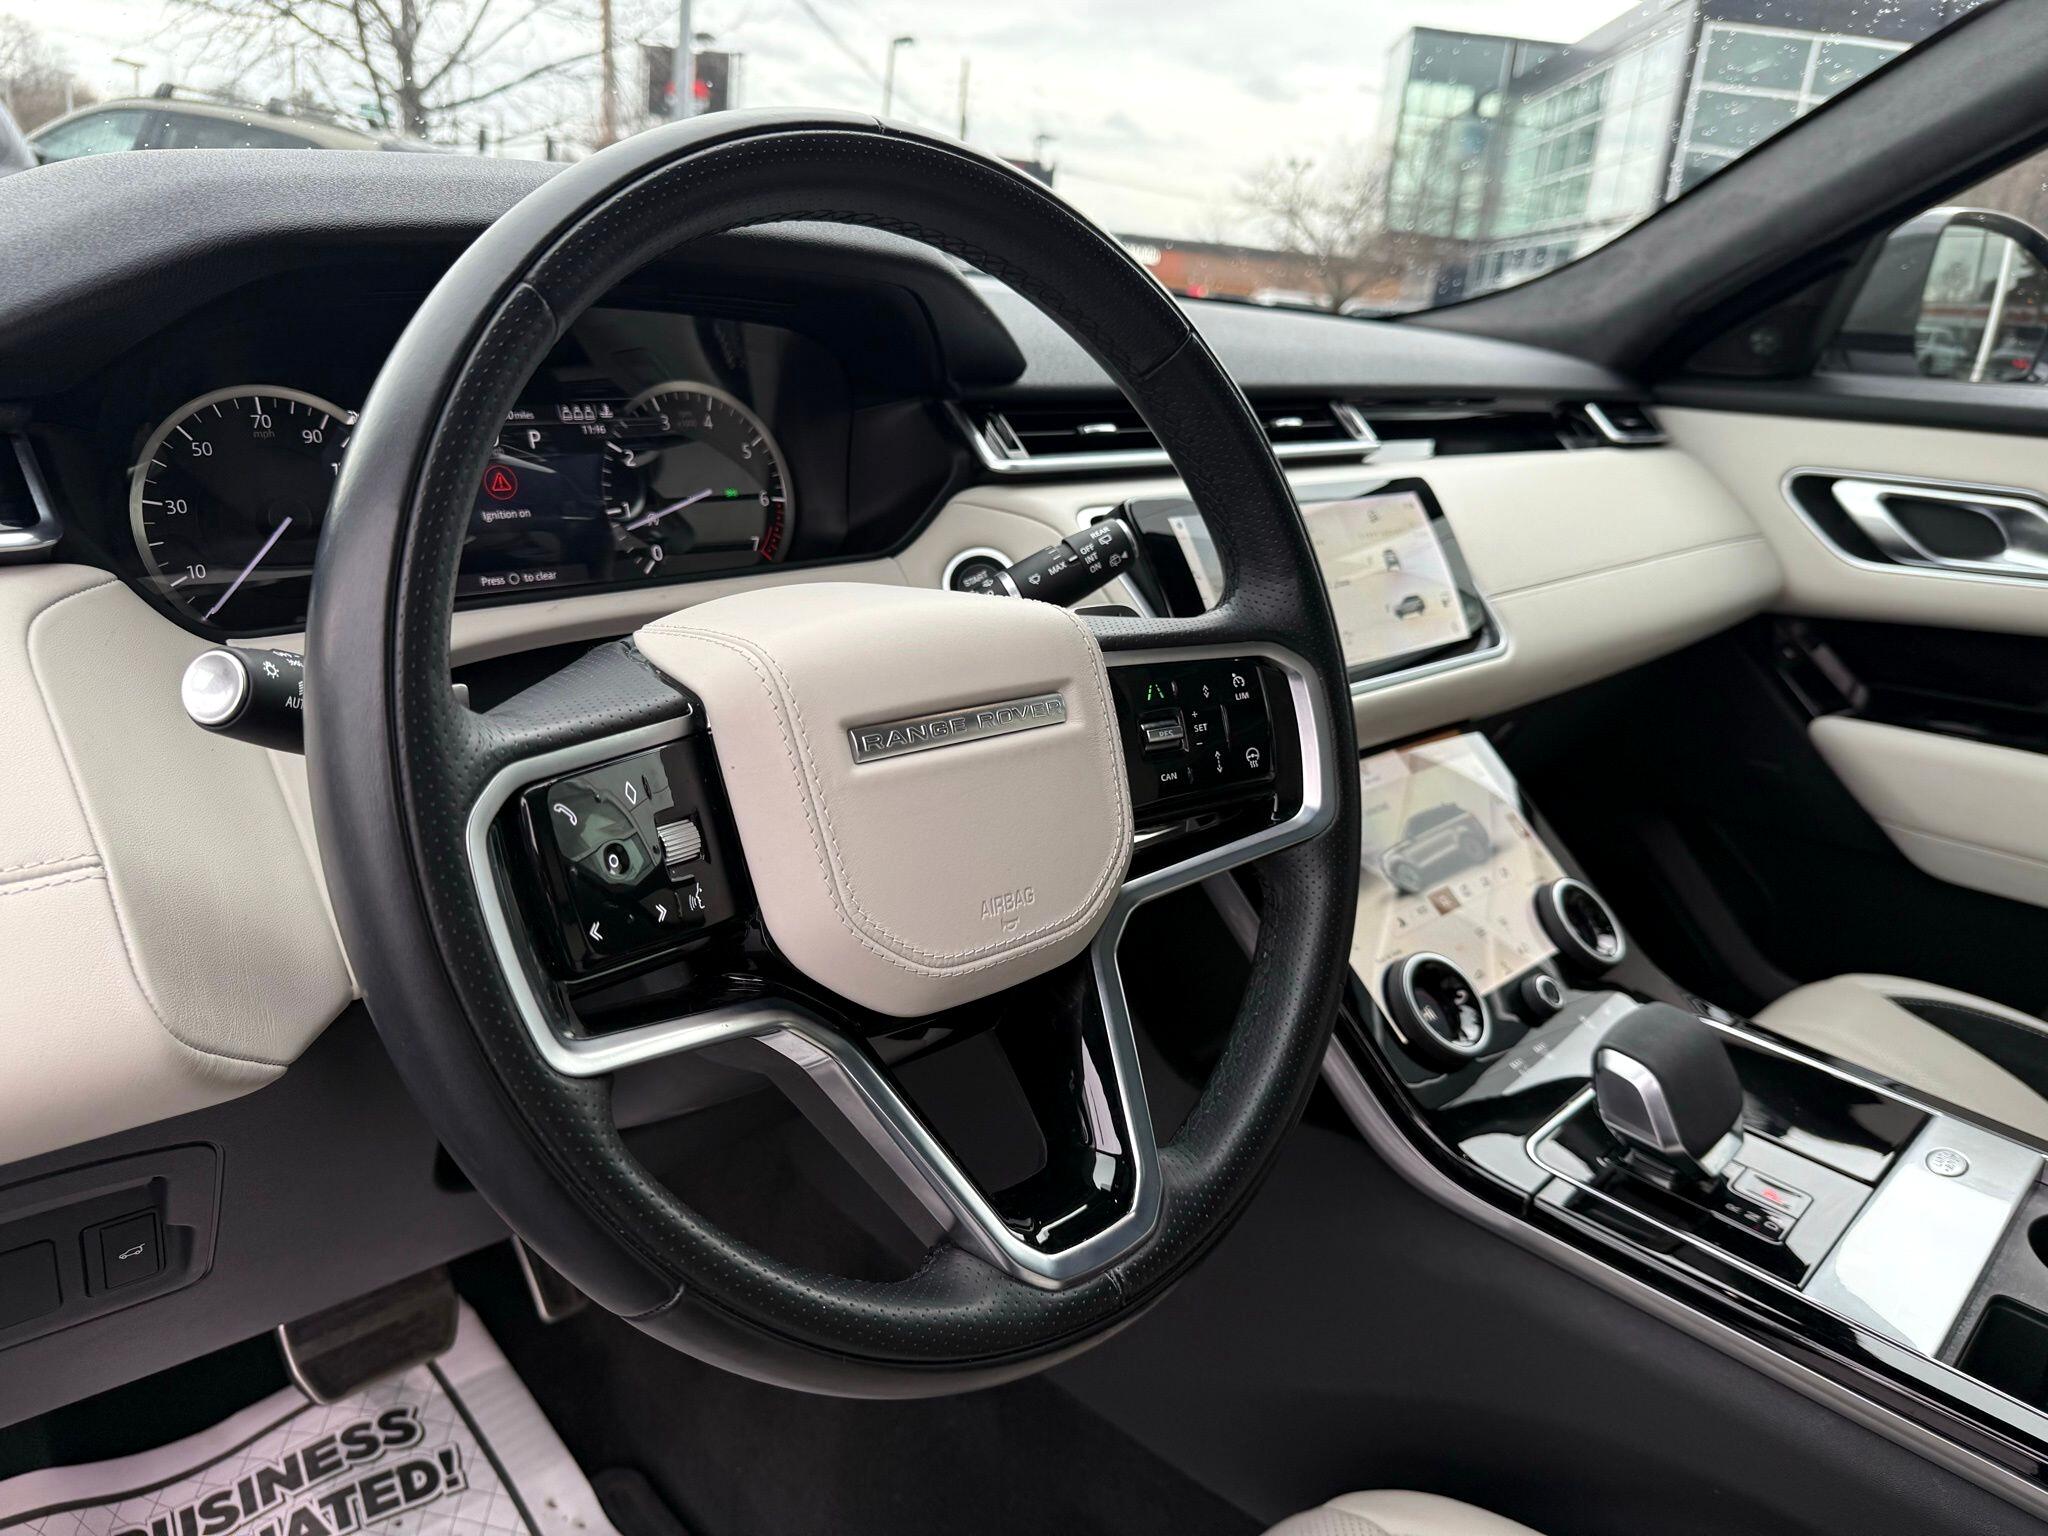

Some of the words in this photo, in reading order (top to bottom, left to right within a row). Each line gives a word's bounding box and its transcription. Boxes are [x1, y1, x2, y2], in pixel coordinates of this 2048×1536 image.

[251, 414, 272, 429] 70
[514, 410, 535, 420] miles
[661, 415, 671, 431] 3
[704, 414, 713, 430] 4
[253, 429, 275, 440] mph
[302, 429, 323, 444] 90
[528, 430, 541, 449] P
[191, 441, 213, 457] 50
[742, 444, 752, 460] 5
[624, 451, 636, 467] 2
[759, 490, 770, 507] 6
[166, 499, 188, 515] 30
[623, 502, 632, 518] 1
[481, 510, 517, 523] Ignition
[519, 509, 532, 519] on
[1090, 526, 1111, 540] REAR
[751, 537, 759, 551] 7
[1080, 543, 1095, 556] OFF
[651, 545, 663, 561] 0
[1084, 552, 1099, 565] INT
[186, 563, 207, 579] 10
[1048, 560, 1068, 576] MAX
[1090, 561, 1102, 573] ON
[481, 577, 506, 587] Press
[524, 573, 535, 582] to
[536, 571, 557, 582] clear
[1234, 691, 1250, 701] LIM
[862, 717, 969, 752] RANGE
[976, 698, 1064, 730] ROVER
[1193, 723, 1208, 733] SET
[1160, 771, 1178, 782] CAN
[980, 886, 1036, 920] AIRBAG
[113, 1406, 422, 1536] USINESS
